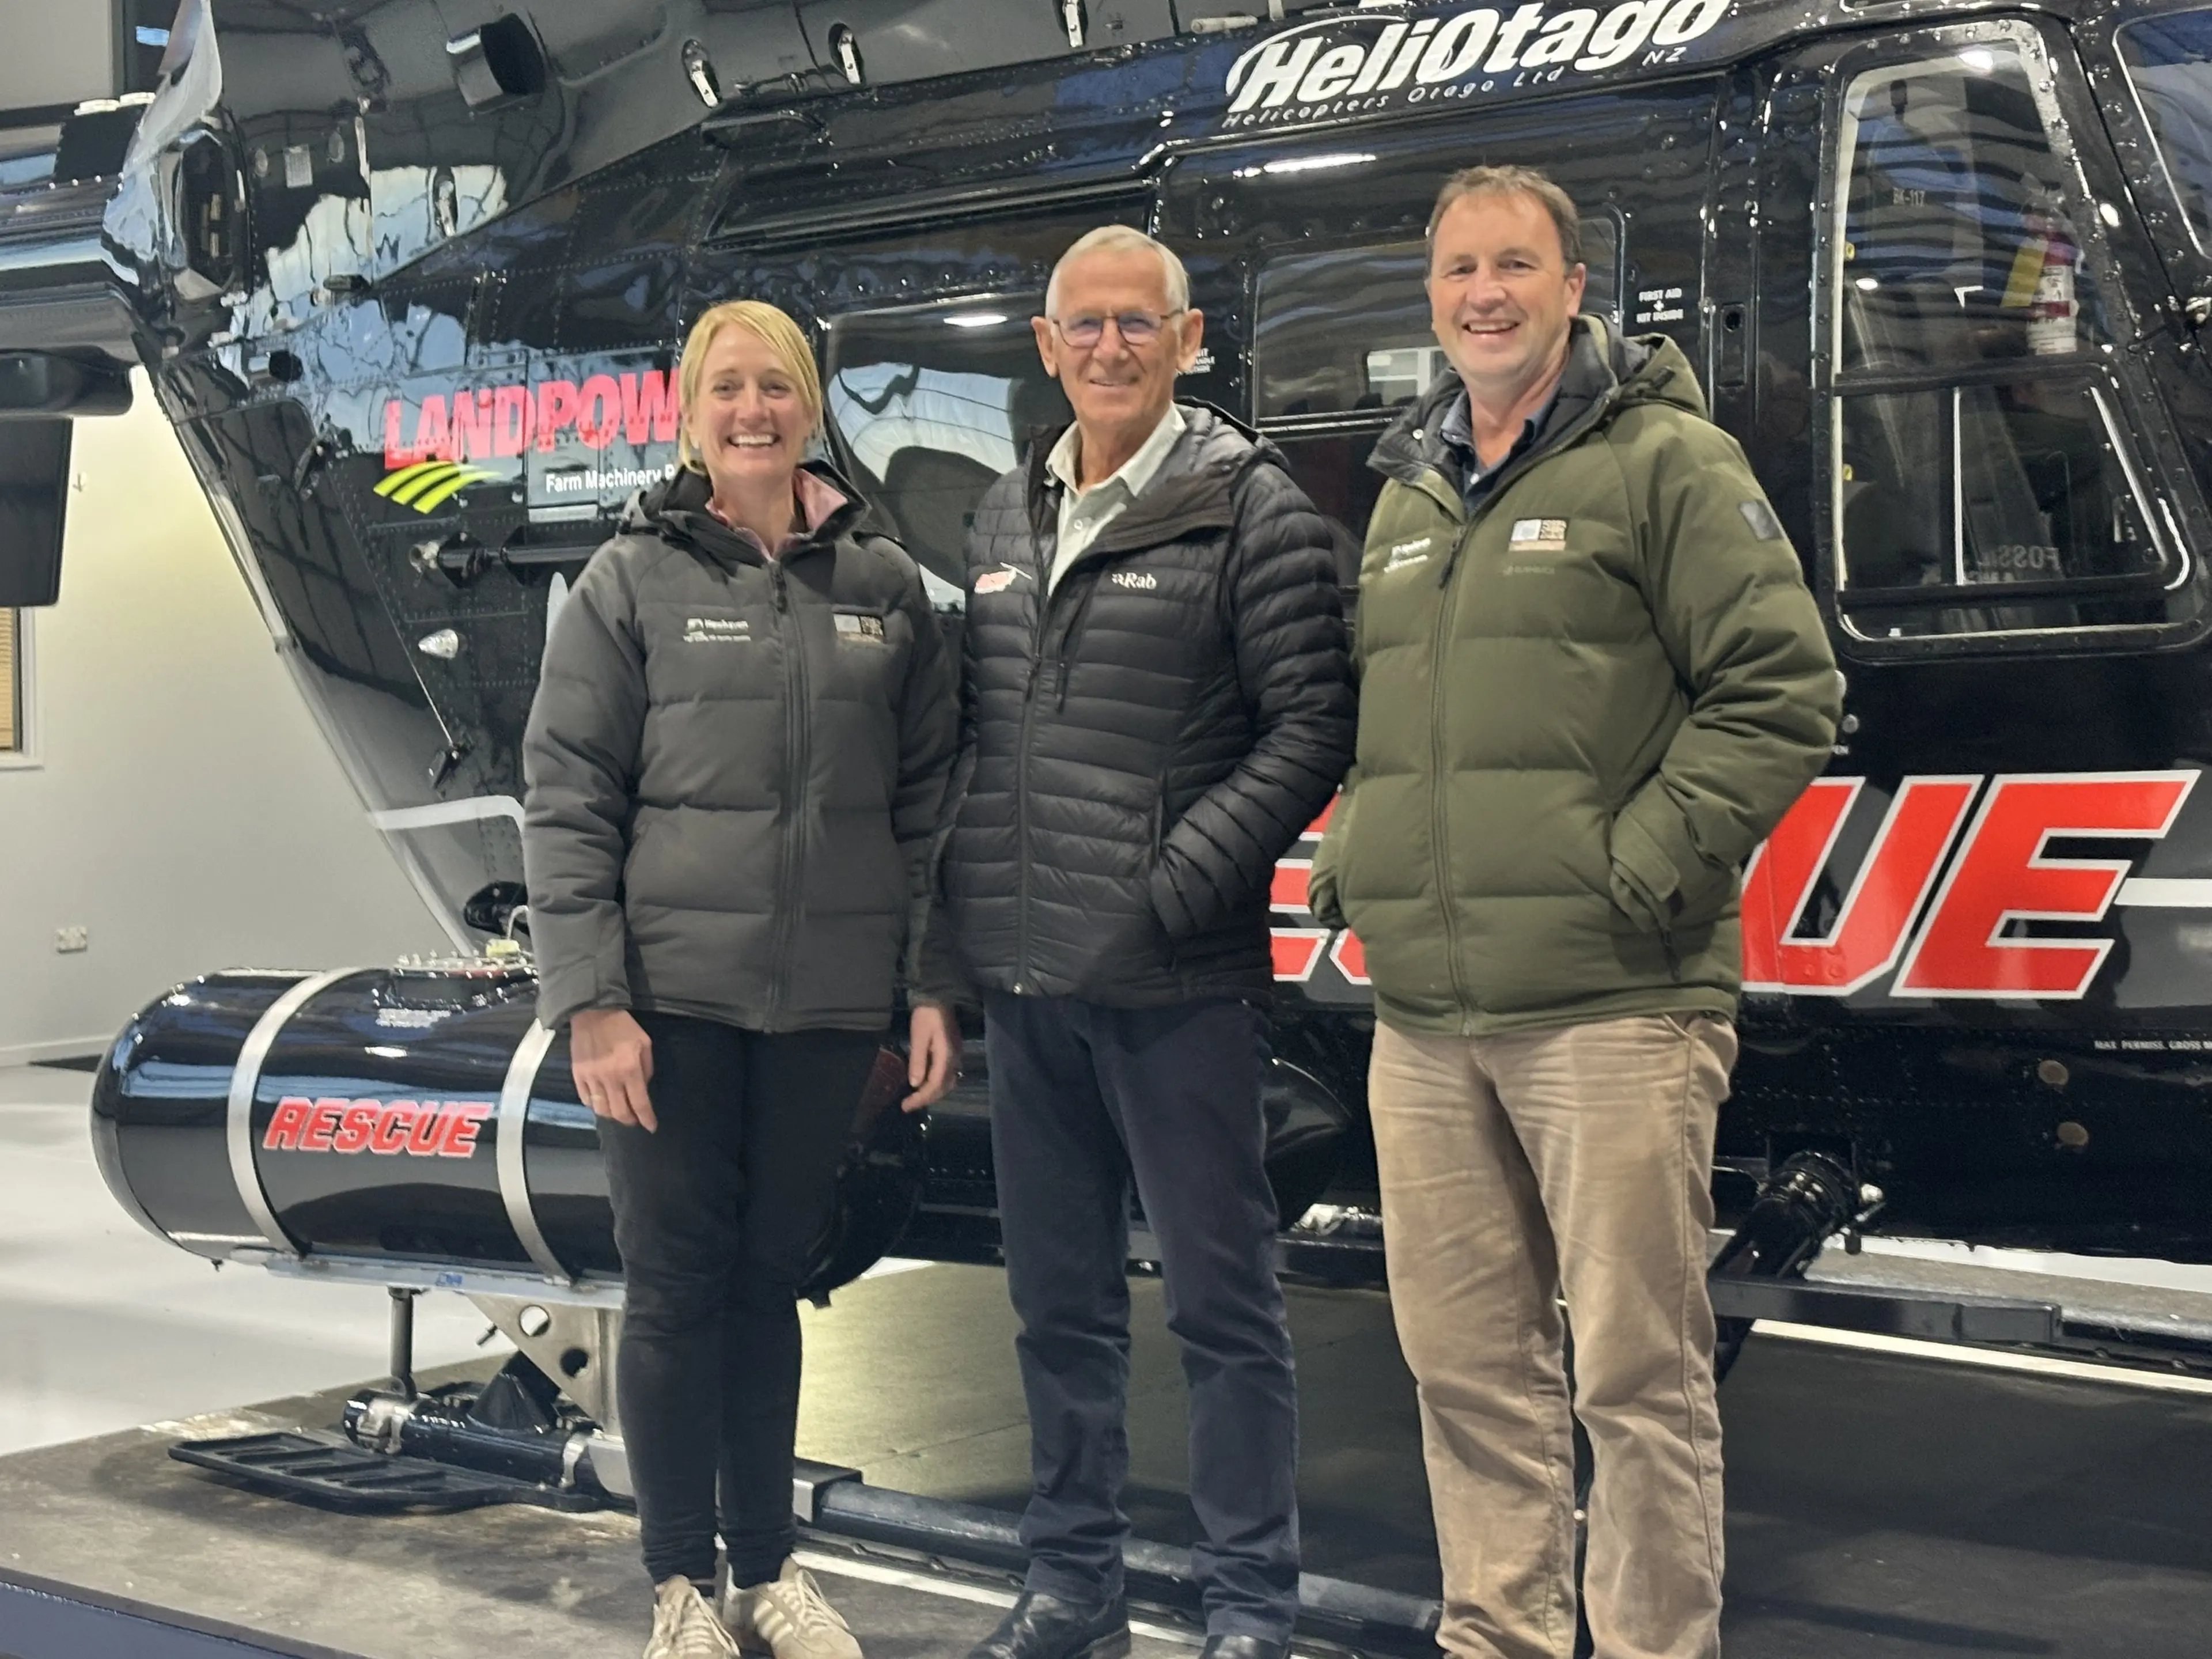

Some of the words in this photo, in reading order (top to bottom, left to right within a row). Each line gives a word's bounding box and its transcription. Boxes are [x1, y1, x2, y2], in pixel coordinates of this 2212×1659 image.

[1228, 0, 1728, 113] HeliOtago
[1642, 47, 1682, 66] NZ
[1221, 94, 1390, 129] Helicopters
[1407, 79, 1495, 104] Otago
[1513, 66, 1565, 87] Ltd
[1665, 287, 1683, 299] AID
[546, 474, 582, 494] Farm
[585, 467, 662, 490] Machinery
[1124, 572, 1157, 589] Rab
[263, 1096, 495, 1158] RESCUE
